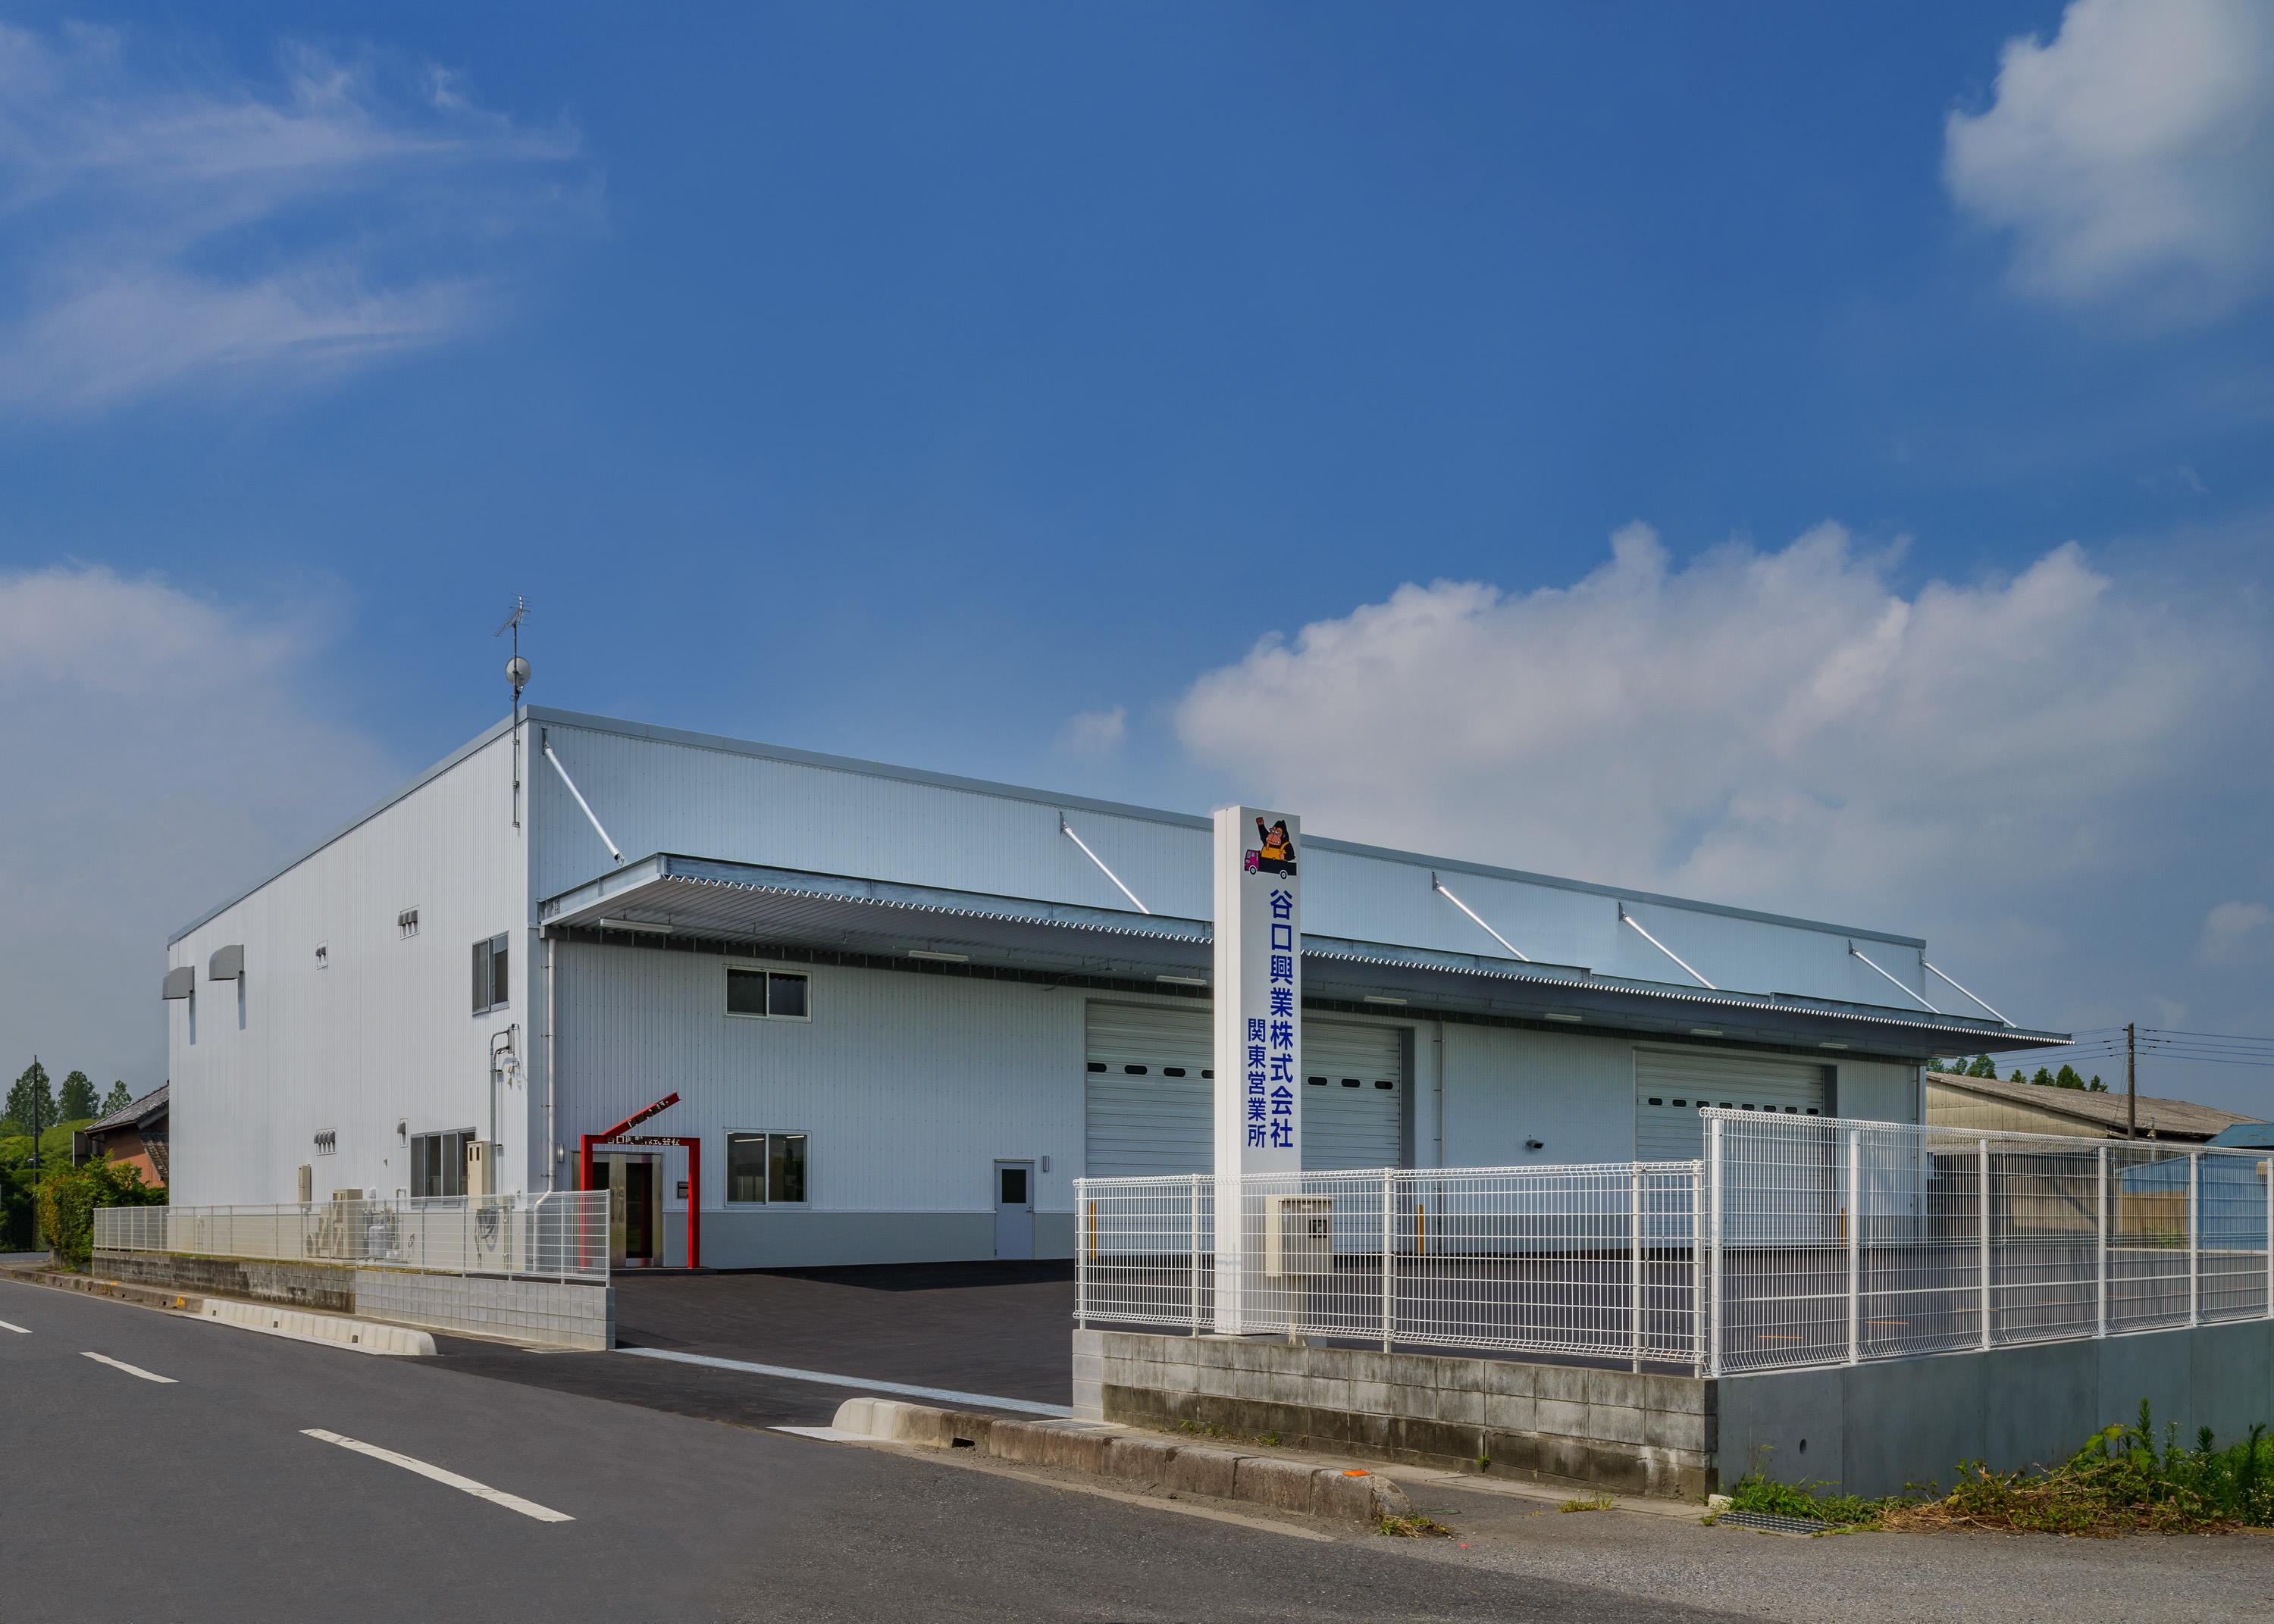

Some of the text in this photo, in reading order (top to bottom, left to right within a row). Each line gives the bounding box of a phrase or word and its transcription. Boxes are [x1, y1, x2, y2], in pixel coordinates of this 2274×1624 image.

[1248, 1019, 1267, 1148] 関東営業所
[1270, 890, 1293, 1148] 谷口興業株式会社
